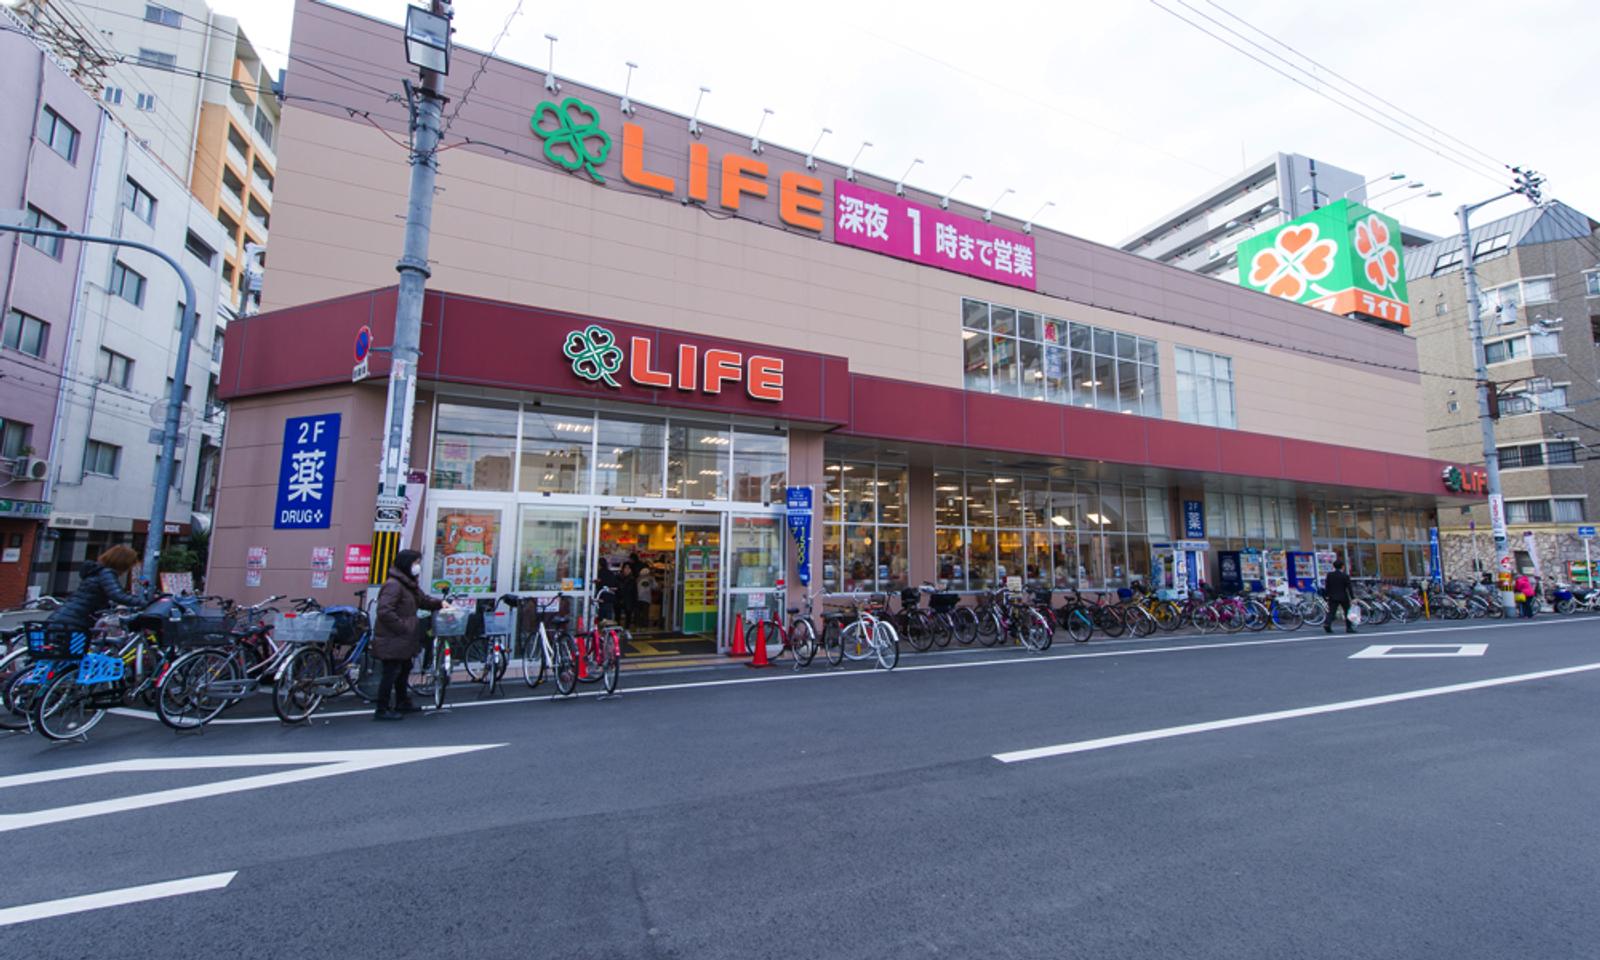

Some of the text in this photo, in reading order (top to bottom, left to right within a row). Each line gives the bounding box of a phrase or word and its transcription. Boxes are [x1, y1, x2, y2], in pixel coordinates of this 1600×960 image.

[621, 121, 824, 233] LIFE
[1362, 293, 1403, 321] ライフ
[630, 335, 784, 402] LIFE
[297, 420, 326, 444] 2F
[287, 448, 327, 502] 薬
[1461, 467, 1488, 494] LIF
[281, 509, 313, 523] DRUG
[446, 556, 489, 566] Ponta
